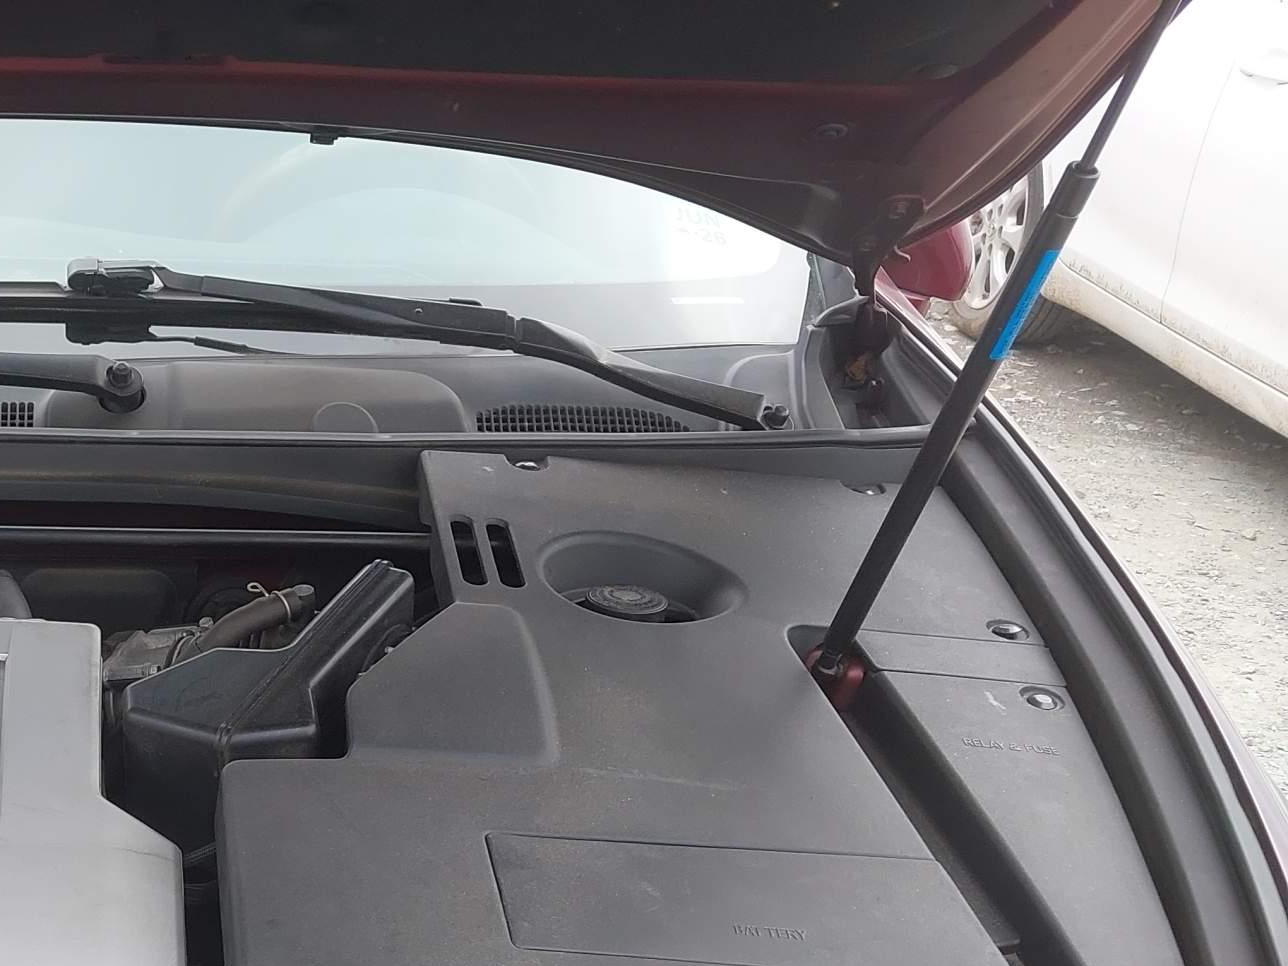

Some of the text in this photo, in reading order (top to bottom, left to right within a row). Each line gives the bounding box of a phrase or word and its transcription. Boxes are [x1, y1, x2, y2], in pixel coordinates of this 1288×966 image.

[962, 737, 1005, 752] RELAY
[1023, 743, 1061, 757] FUSE
[732, 924, 806, 942] BATTERY
